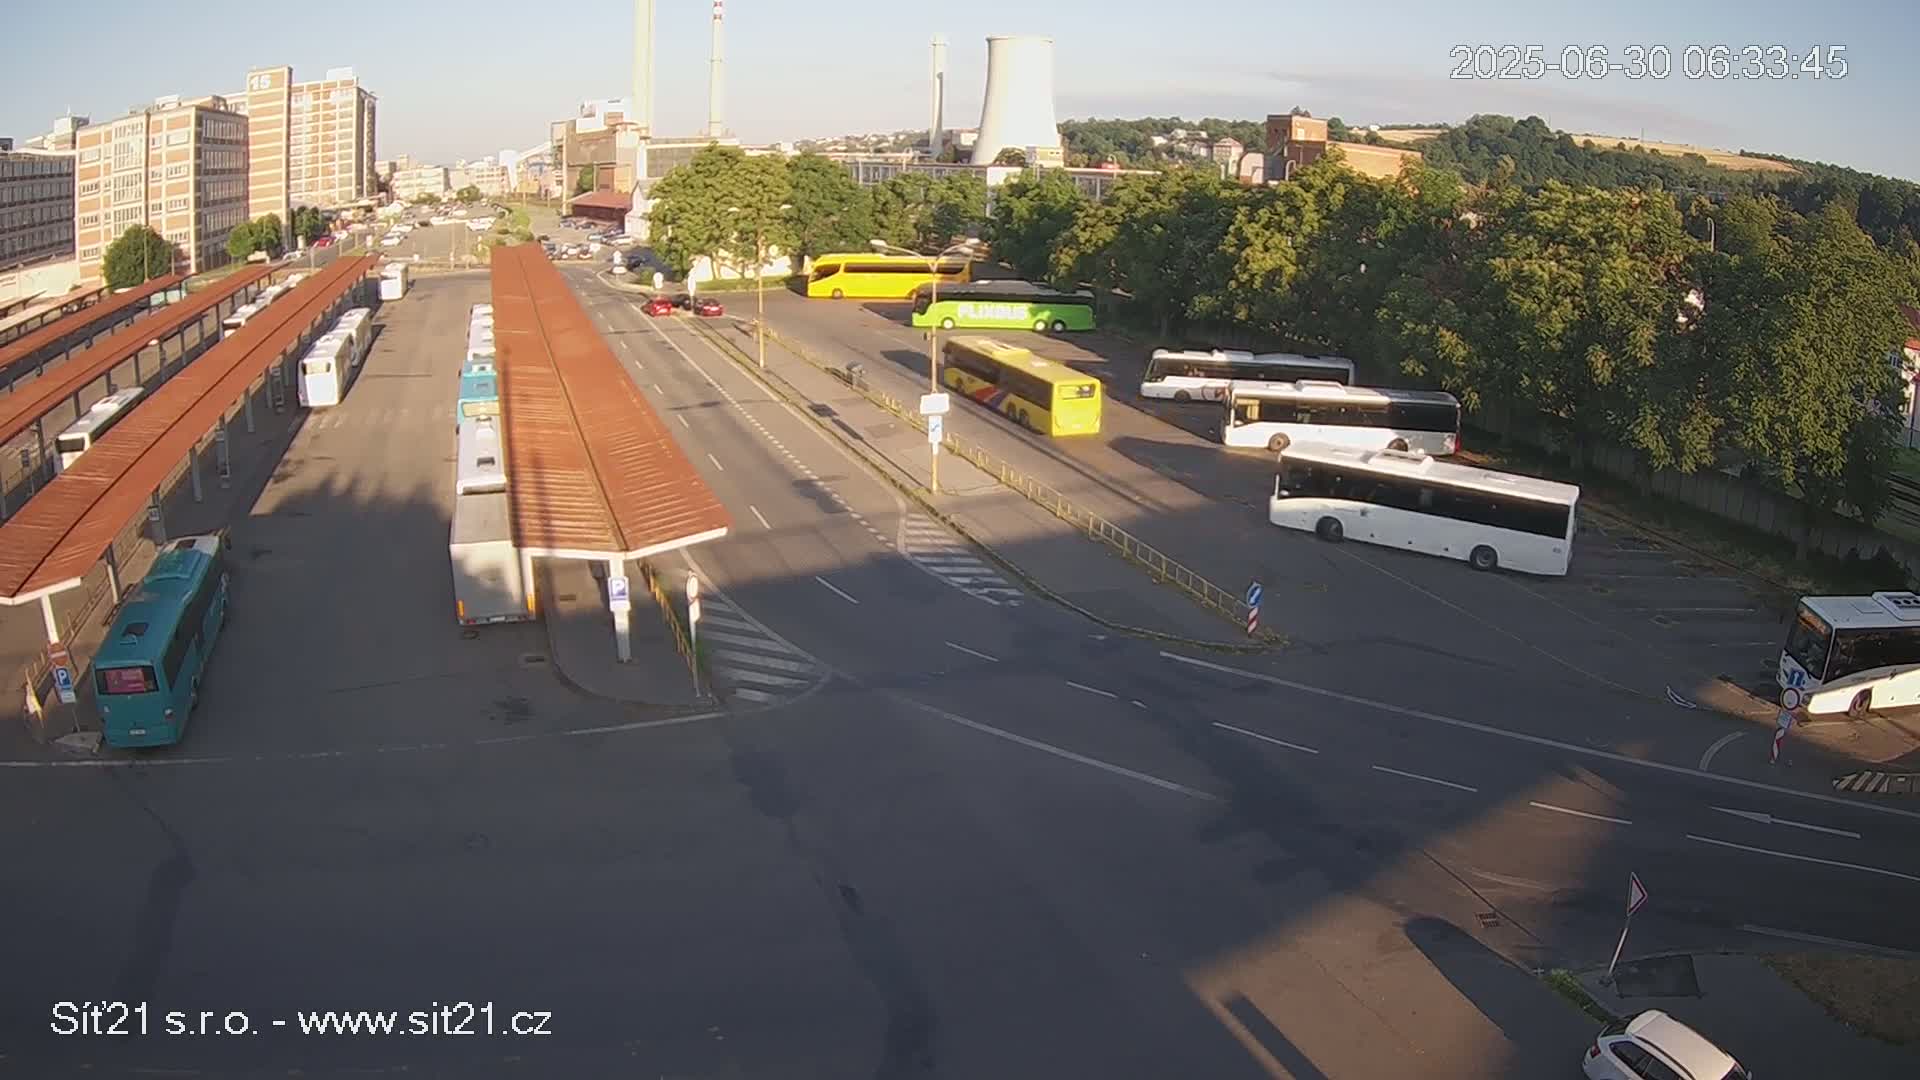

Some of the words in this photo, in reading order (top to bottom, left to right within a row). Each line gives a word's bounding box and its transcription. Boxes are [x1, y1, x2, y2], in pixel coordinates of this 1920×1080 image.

[250, 75, 270, 90] 15
[958, 303, 1027, 320] FLIXBUS
[612, 579, 625, 596] P
[58, 670, 67, 685] P
